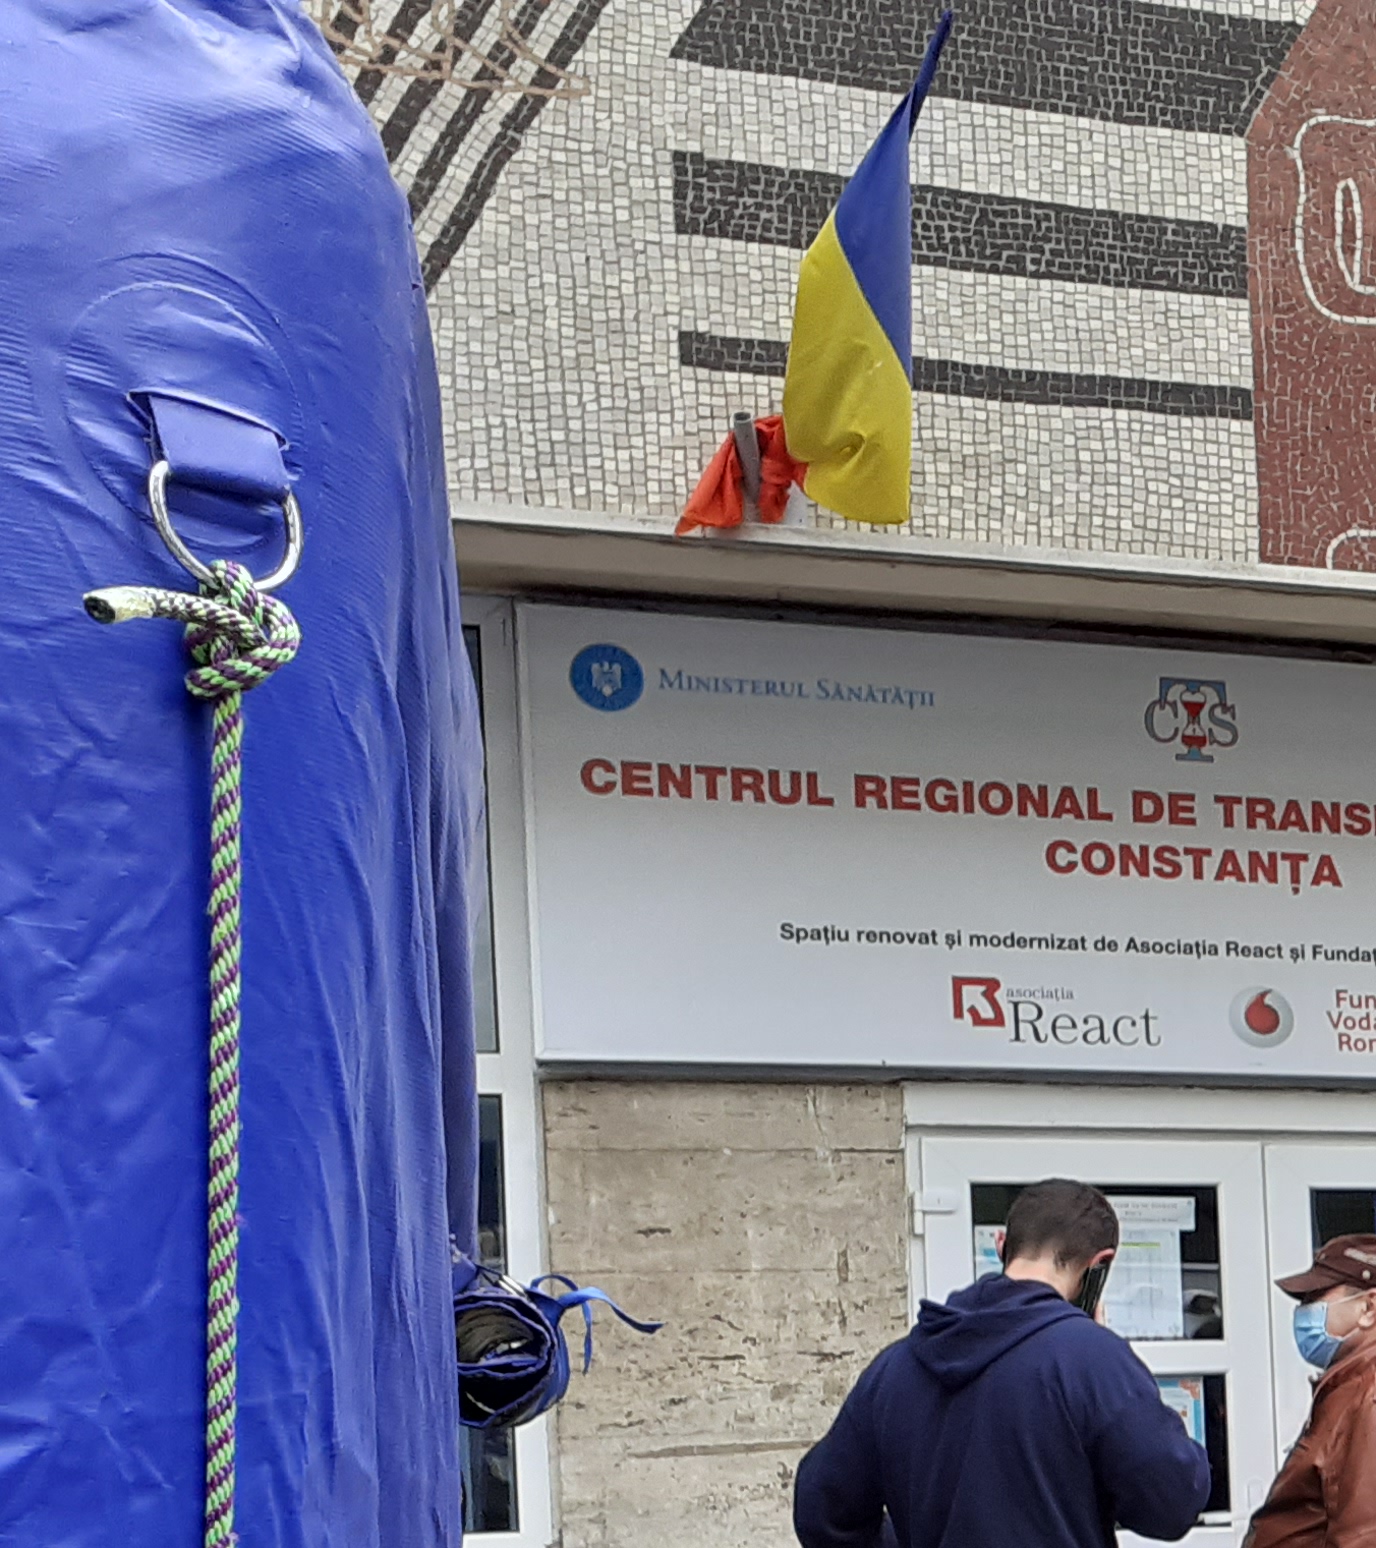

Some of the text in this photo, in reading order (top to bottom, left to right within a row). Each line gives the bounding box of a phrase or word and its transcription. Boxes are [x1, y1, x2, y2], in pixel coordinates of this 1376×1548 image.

[659, 668, 809, 698] MINISTERUL
[580, 758, 835, 807] CENTRUL
[854, 775, 1113, 822] REGIONAL
[1132, 790, 1197, 825] DE
[1045, 840, 1343, 894] CONSTANȚA
[856, 927, 938, 946] renovat
[968, 930, 1088, 951] modernizat
[1094, 934, 1119, 953] de
[1226, 941, 1283, 960] React
[1008, 1001, 1161, 1047] React
